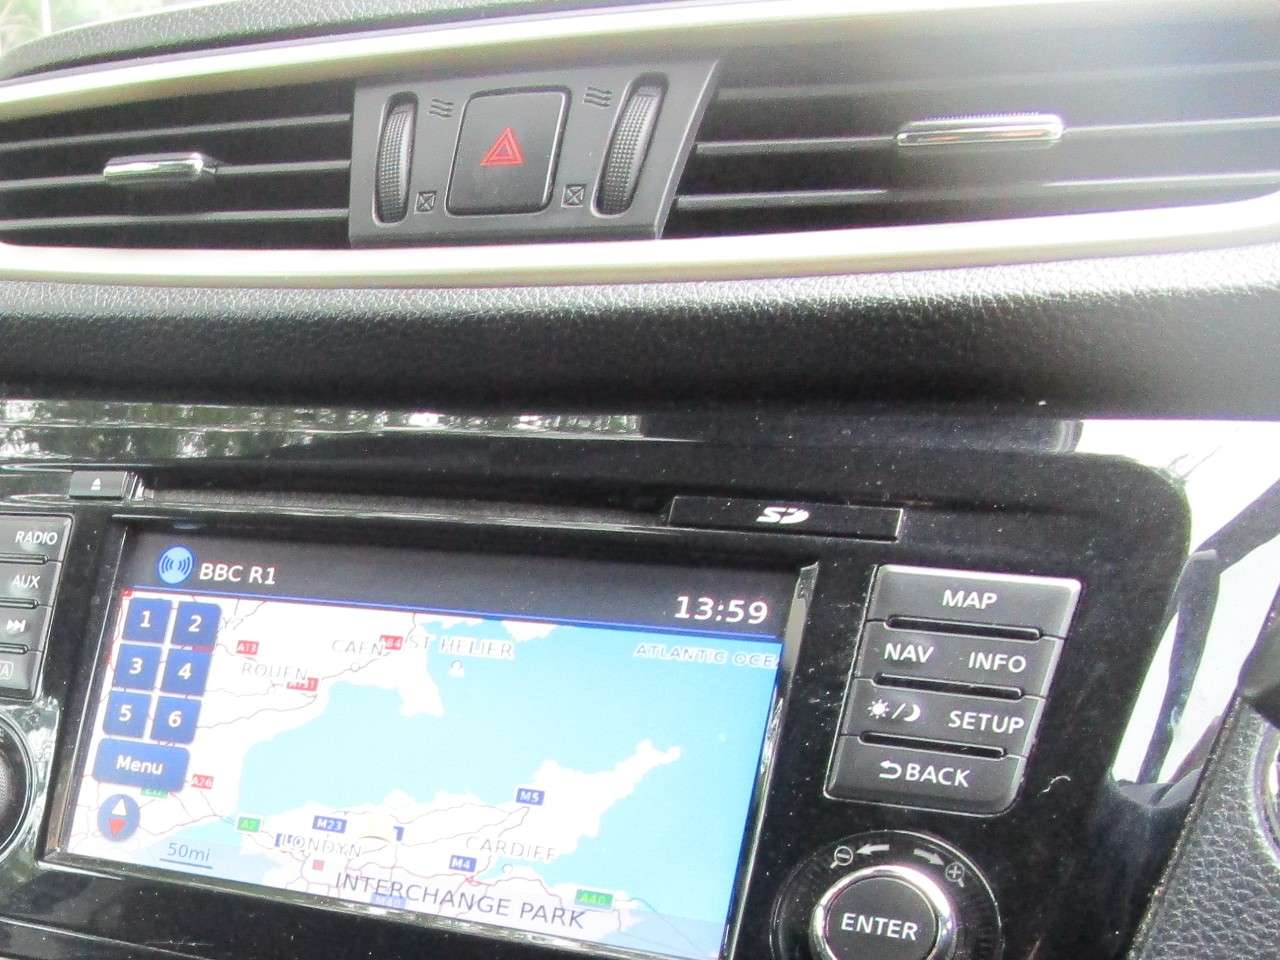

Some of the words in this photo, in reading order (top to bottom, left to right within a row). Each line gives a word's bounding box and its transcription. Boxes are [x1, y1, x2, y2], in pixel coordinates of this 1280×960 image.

[15, 530, 58, 546] RADIO
[12, 573, 41, 589] AUX
[199, 563, 243, 583] BBC
[249, 566, 277, 586] R1
[674, 595, 769, 625] 13:59
[942, 590, 998, 610] MAP
[140, 610, 152, 628] 1
[188, 614, 203, 632] 2
[635, 643, 726, 664] ATLANTIC
[883, 642, 935, 664] NAV
[968, 651, 1027, 674] INFO
[129, 656, 144, 675] 3
[178, 662, 192, 680] 4
[118, 704, 133, 722] 5
[167, 710, 182, 728] 6
[948, 710, 1026, 735] SETUP
[116, 754, 164, 776] Menu
[905, 762, 971, 788] BACK
[316, 818, 343, 831] M23
[167, 841, 211, 863] 50mi
[335, 871, 512, 917] INTERCHANGE
[519, 901, 584, 930] PARK
[841, 912, 919, 941] ENTER
